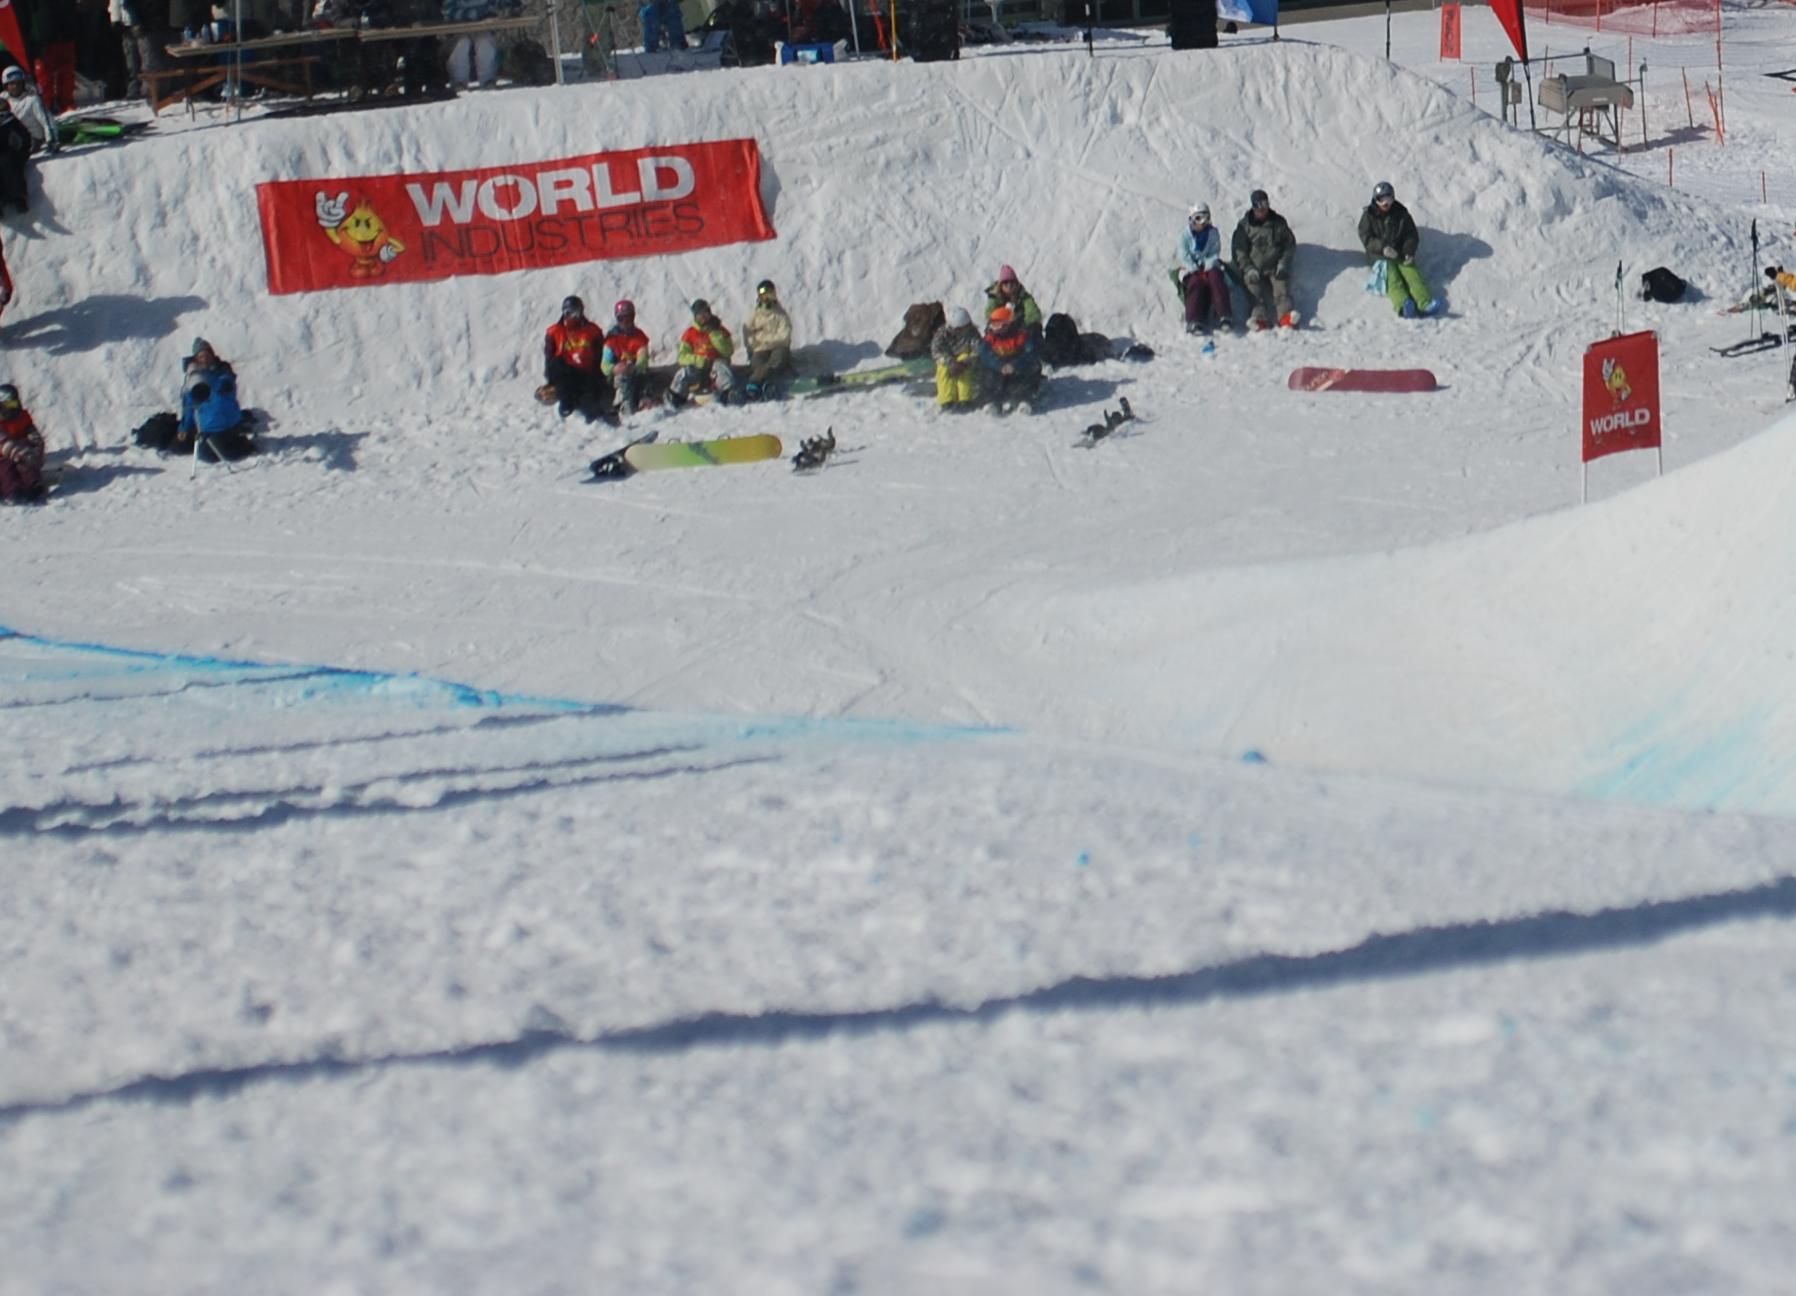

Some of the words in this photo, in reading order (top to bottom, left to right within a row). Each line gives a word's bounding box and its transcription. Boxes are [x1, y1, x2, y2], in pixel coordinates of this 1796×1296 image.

[406, 155, 695, 226] WORLD
[420, 204, 705, 261] INDUSTRIES
[1590, 407, 1650, 436] WORLD
